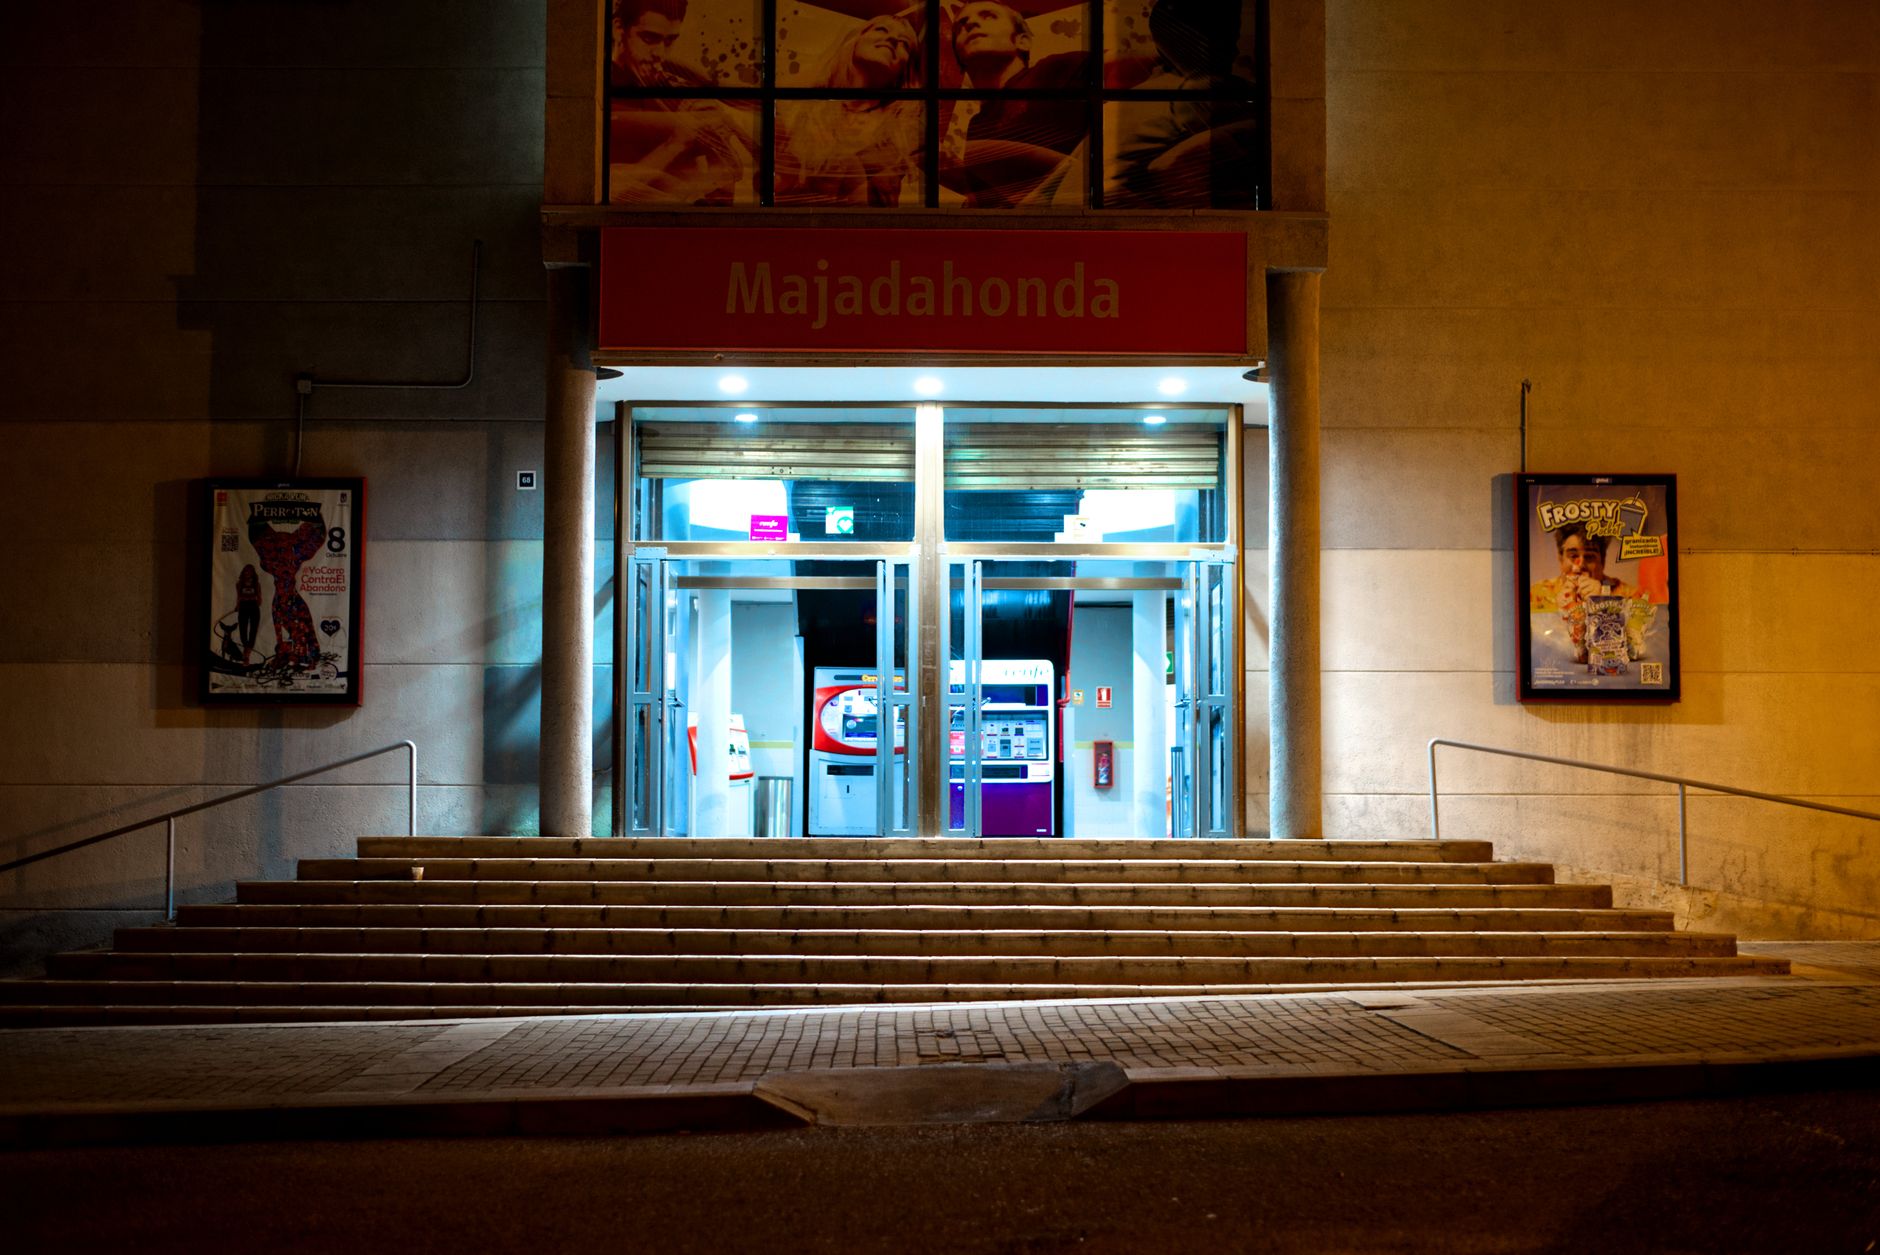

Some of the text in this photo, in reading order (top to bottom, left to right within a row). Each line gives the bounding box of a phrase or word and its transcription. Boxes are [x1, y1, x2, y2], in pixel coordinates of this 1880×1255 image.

[725, 258, 1122, 331] Majadahonda
[1540, 500, 1618, 528] FROSTY
[1587, 519, 1622, 539] Pocket
[327, 527, 346, 552] 8
[1624, 537, 1658, 545] granizado
[301, 575, 345, 584] ContraEl
[301, 584, 347, 592] Abandono
